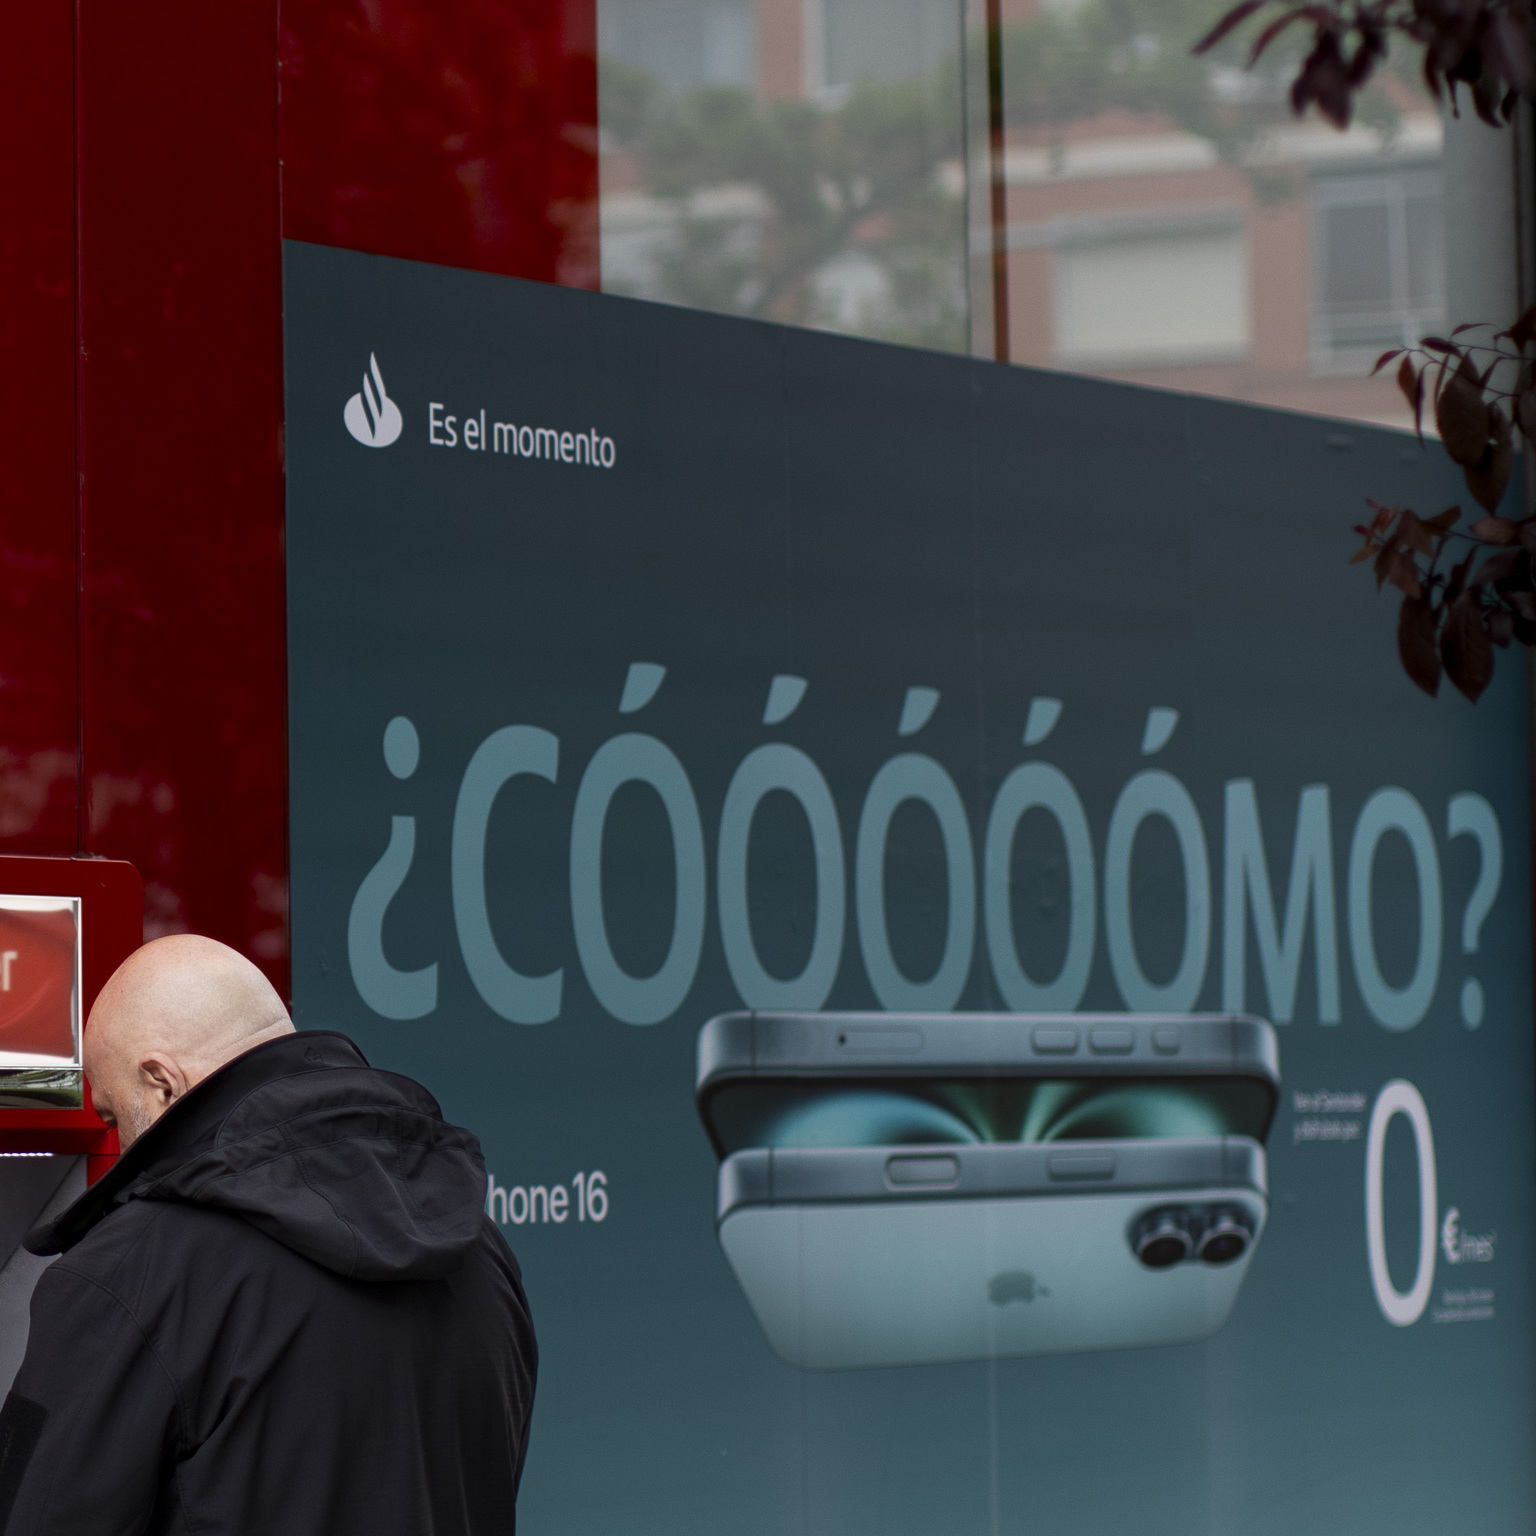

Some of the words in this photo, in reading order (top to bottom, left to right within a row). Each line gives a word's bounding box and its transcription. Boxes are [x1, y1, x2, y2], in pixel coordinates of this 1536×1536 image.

[428, 401, 459, 447] Es
[464, 408, 487, 452] el
[493, 421, 617, 470] momento
[346, 660, 1505, 1035] ¿CÓÓÓÓÓMO?
[488, 1173, 569, 1226] hone
[572, 1169, 609, 1223] 16
[1364, 1076, 1439, 1328] 0
